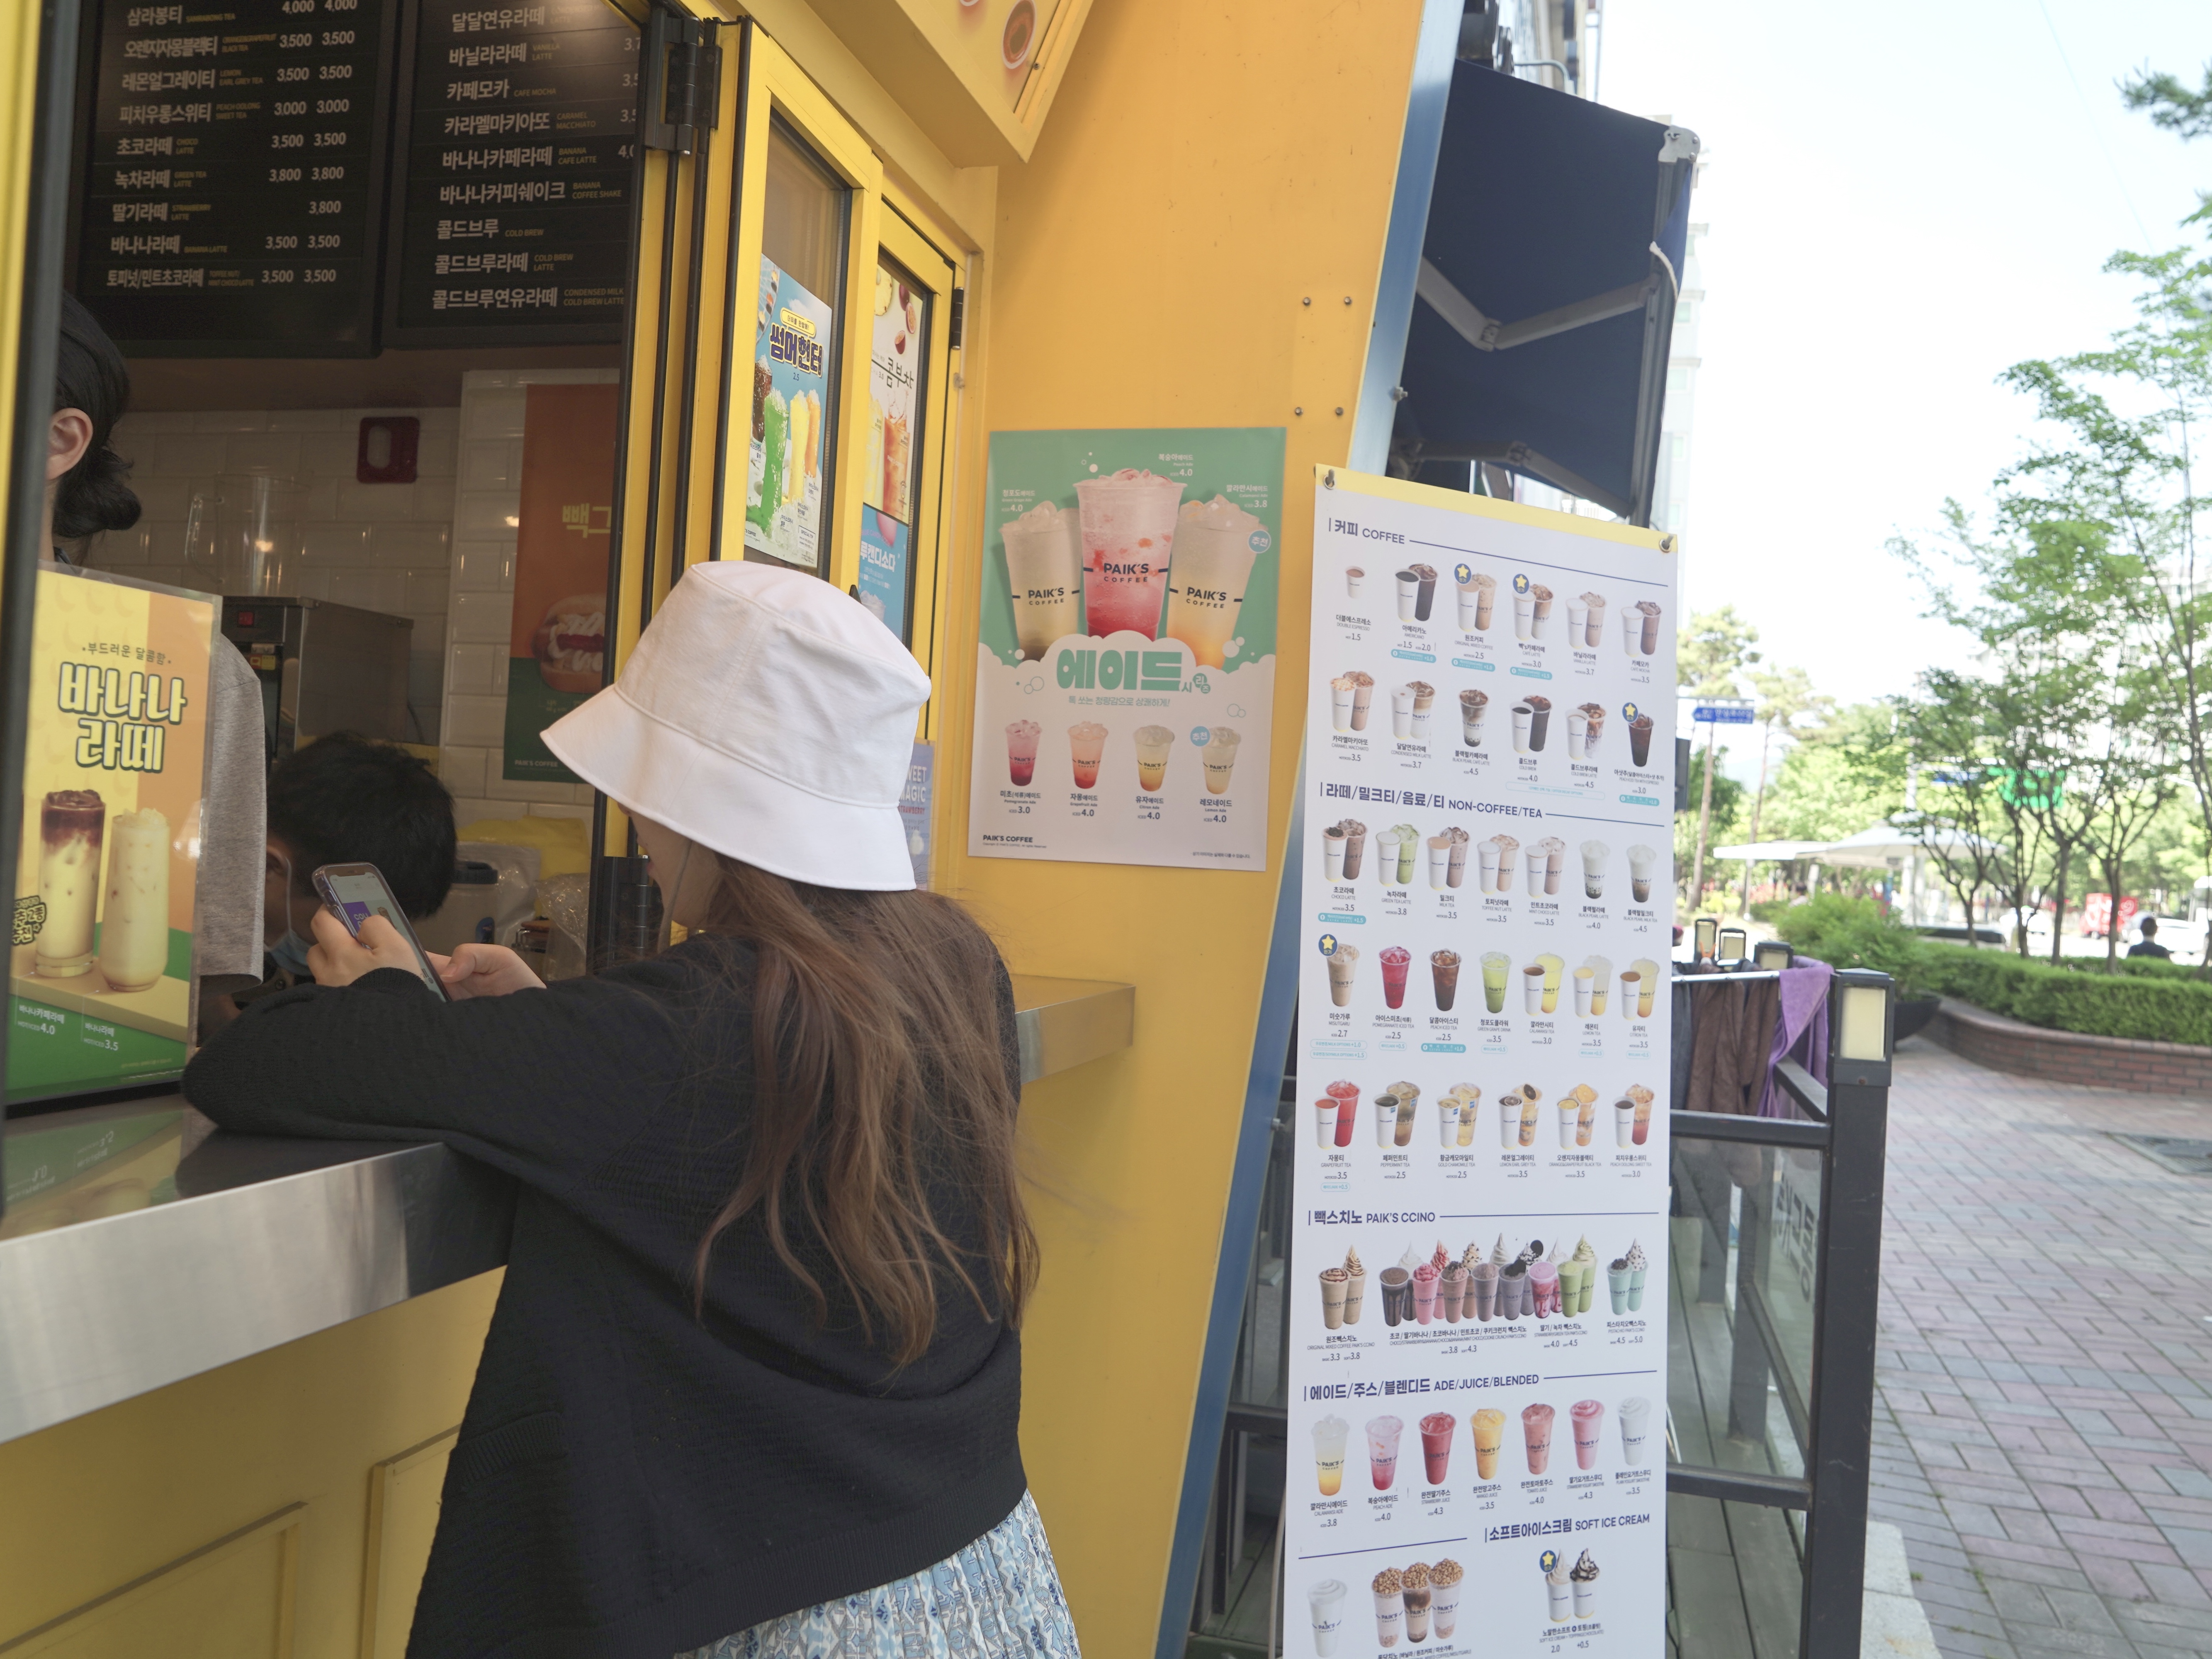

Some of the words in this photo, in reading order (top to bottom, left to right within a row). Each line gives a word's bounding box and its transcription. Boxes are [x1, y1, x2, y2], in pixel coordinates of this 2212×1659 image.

[282, 0, 314, 13] 4,000
[127, 5, 182, 27] 삼라봉티
[452, 6, 545, 32] 달달연유라떼
[124, 36, 218, 58] 오렌지자몽블랙티
[280, 34, 312, 48] 3,500
[322, 30, 355, 46] 3,500
[532, 43, 560, 51] VANILLA
[450, 43, 527, 67] 바닐라라떼
[532, 52, 552, 61] LATTE
[123, 70, 215, 91] 레몬얼그레이티
[277, 68, 309, 82] 3,500
[319, 65, 352, 79] 3,500
[447, 79, 509, 101] 카페모카
[531, 88, 556, 96] MOCHA
[120, 103, 211, 124] 피치우롱스위티
[275, 102, 306, 116] 3,000
[316, 99, 349, 113] 3,000
[445, 112, 550, 136] 카라멜마키아또
[117, 136, 173, 156] 초코라떼
[271, 135, 304, 148] 3,500
[314, 132, 346, 146] 3,500
[443, 146, 553, 170] 바나나카페라떼
[115, 170, 171, 189] 녹차라떼
[269, 168, 301, 182] 3,800
[311, 166, 344, 180] 3,800
[440, 181, 565, 205] 바나나커피쉐이크
[572, 191, 598, 199] COFFEE
[600, 189, 621, 197] SHAKE
[112, 202, 168, 222] 딸기라떼
[309, 200, 341, 214] 3,800
[437, 219, 498, 240] 콜드브루
[111, 236, 180, 255] 바나나라떼
[266, 236, 298, 249] 3,500
[308, 235, 340, 248] 3,500
[435, 252, 529, 275] 콜드브루라떼
[107, 268, 204, 289] 토피넛/민트초코라떼
[262, 270, 294, 284] 3,500
[304, 269, 336, 283] 3,500
[433, 287, 558, 309] 콜드브루연유라떼
[770, 324, 822, 377] 썸머헌터
[886, 357, 914, 389] 콤부차
[1010, 504, 1023, 512] 4.0
[1335, 520, 1358, 536] 커피
[1362, 528, 1405, 544] COFFEE
[1252, 536, 1269, 547] 추천
[1104, 563, 1149, 575] PAIK'S
[1028, 588, 1065, 599] PAIK'S
[1187, 587, 1226, 601] PAIK'S
[1186, 598, 1224, 608] COFFEE
[1402, 625, 1426, 634] 아메리카노
[1465, 635, 1483, 643] 원조커피
[88, 643, 130, 657] 부드러운
[1057, 649, 1182, 691] 에이드
[1181, 673, 1211, 693] 시리즈
[59, 662, 187, 725] 바나나
[1078, 696, 1093, 705] 쏘는
[1096, 696, 1133, 706] 청량감으로
[1136, 697, 1170, 707] 상쾌하게!
[1191, 732, 1208, 742] 추천
[75, 718, 165, 773] 라떼
[1000, 790, 1041, 799] 미초(석류)에이드
[1070, 793, 1098, 801] 자몽에이드
[1136, 796, 1164, 804] 유자에이드
[1200, 798, 1232, 807] 레모네이드
[1327, 783, 1444, 808] 라떼/밀크티/음료/티
[1449, 800, 1542, 818] NON-COFFEE/TEA
[1147, 811, 1160, 820] 4.0
[1213, 815, 1227, 823] 4.0
[19, 1005, 64, 1024] 바나나카페라떼
[1376, 1014, 1411, 1023] 아이스미초(석류)
[40, 1022, 55, 1034] 4.0
[85, 1022, 114, 1036] 바나나라떼
[105, 1040, 118, 1051] 3.5
[1315, 1210, 1362, 1224] 빽스치노
[1366, 1213, 1398, 1223] PAIK'S
[1401, 1212, 1435, 1222] CCINO
[1310, 1378, 1430, 1400] 에이드/주스/블렌디드
[1434, 1374, 1538, 1391] ADE/JUICE/BLENDED
[1310, 1500, 1347, 1511] 깔라만시에이드
[1490, 1518, 1572, 1541] 소프트아이스크림
[1575, 1519, 1599, 1531] SOFT
[1602, 1517, 1616, 1528] ICE
[1618, 1514, 1650, 1526] CREAM
